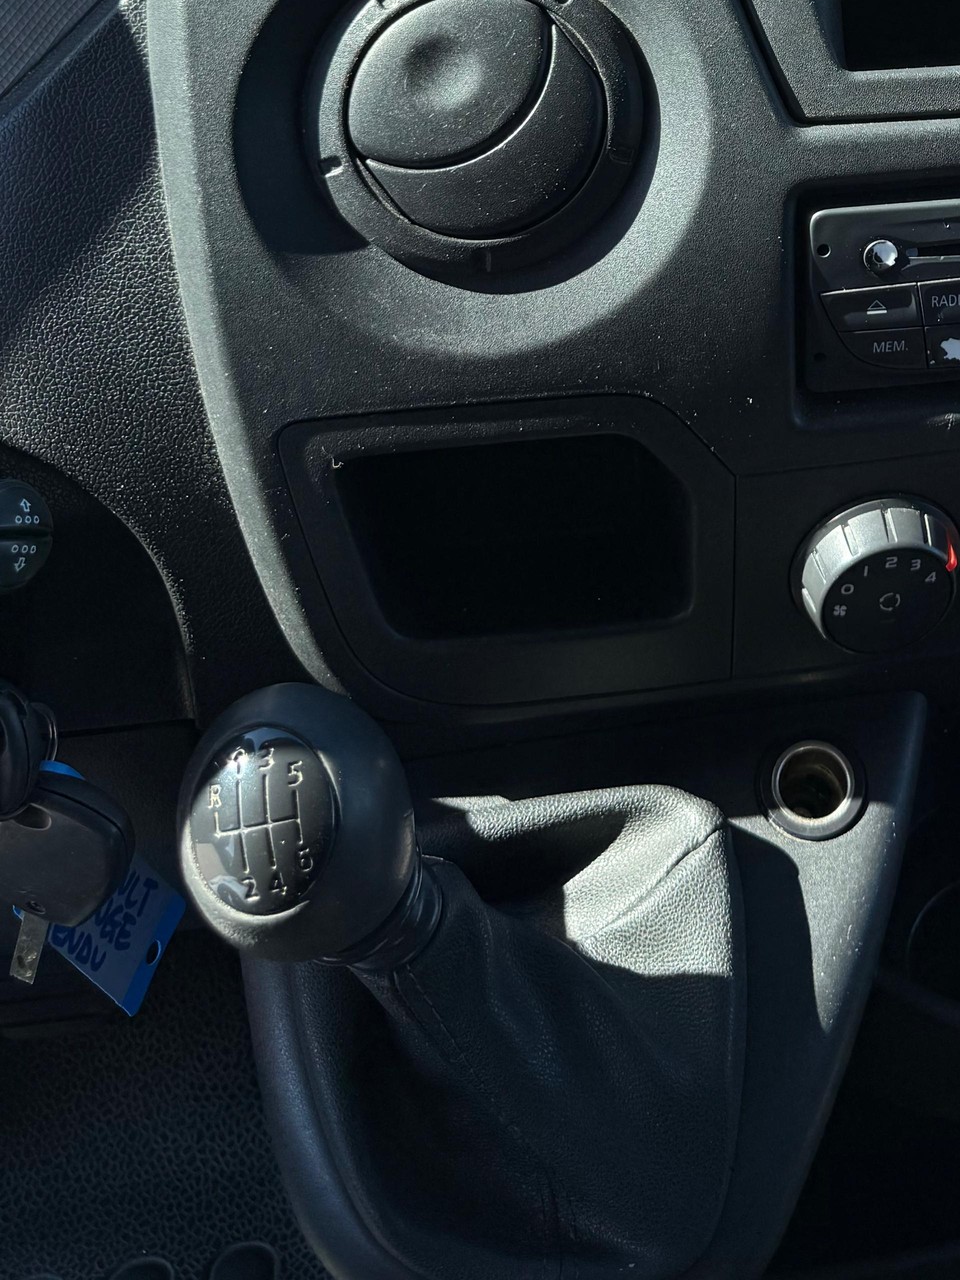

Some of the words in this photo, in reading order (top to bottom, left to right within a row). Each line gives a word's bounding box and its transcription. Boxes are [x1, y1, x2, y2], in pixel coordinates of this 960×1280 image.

[872, 339, 909, 354] MEM.
[863, 565, 869, 578] 1
[885, 556, 898, 569] 2
[910, 558, 921, 571] 3
[841, 583, 854, 595] 0
[925, 572, 937, 584] 4
[259, 746, 275, 770] 3
[288, 760, 303, 787] 5
[208, 784, 221, 809] R
[117, 870, 159, 918] ULT
[241, 876, 261, 901] 2
[269, 871, 287, 895] 4
[51, 923, 107, 973] ENDU
